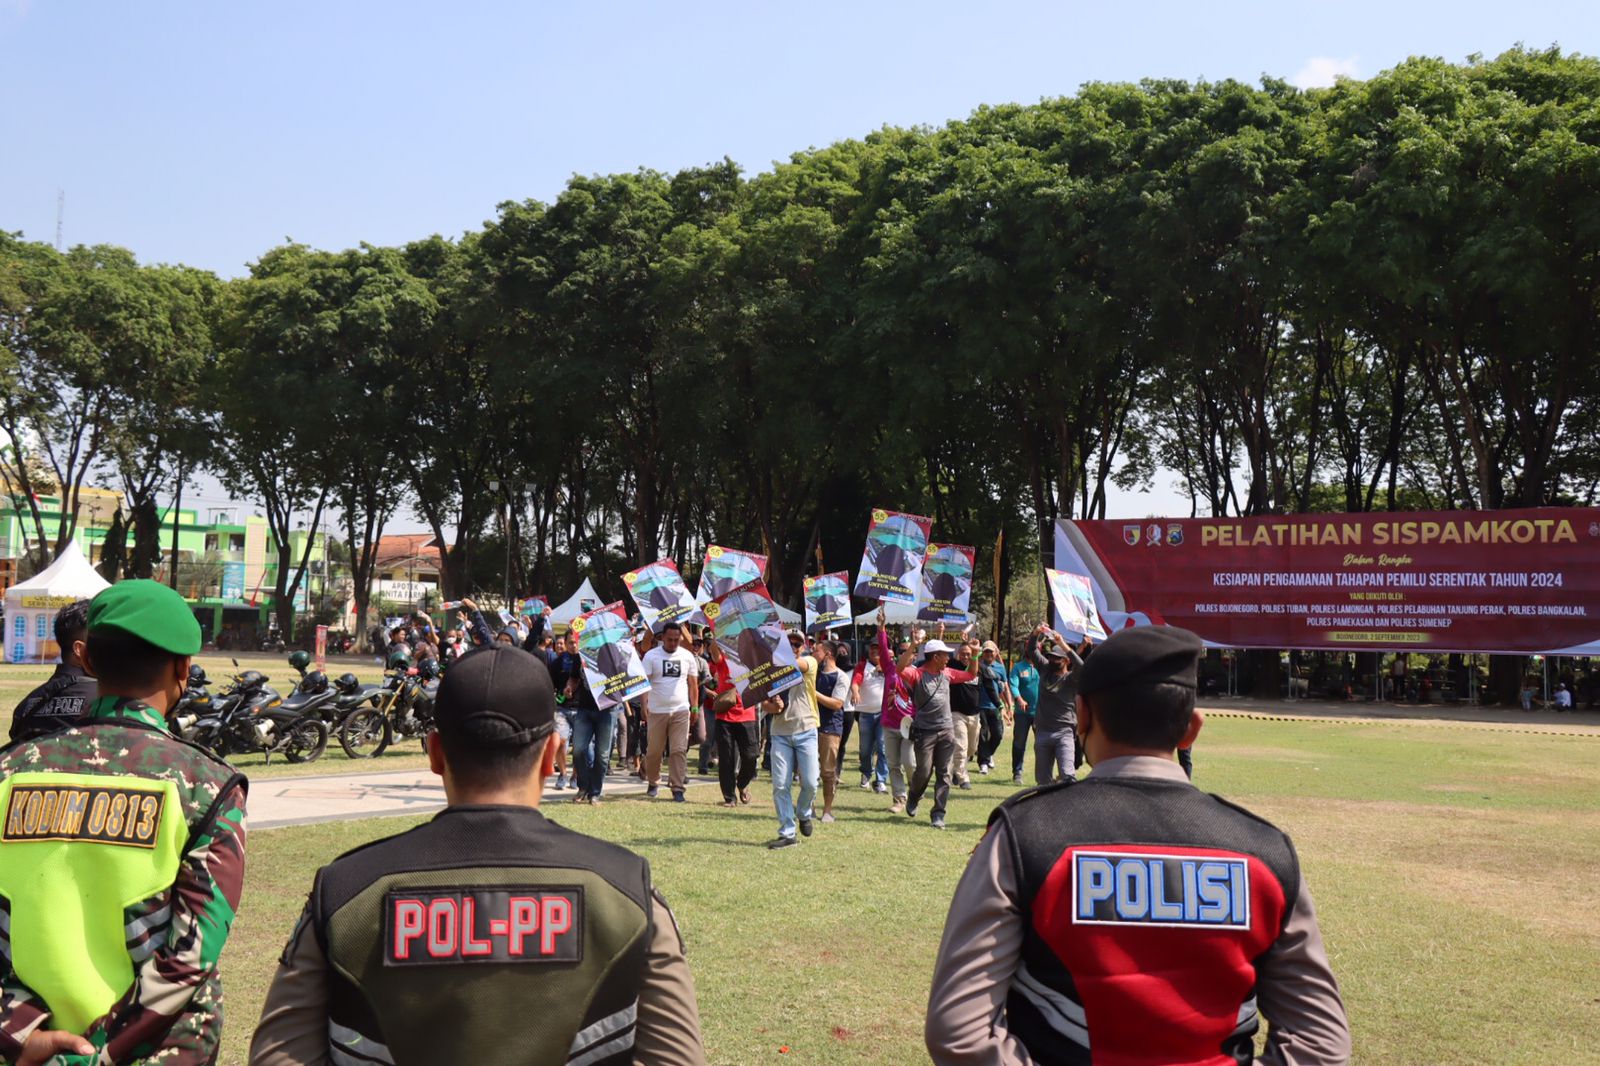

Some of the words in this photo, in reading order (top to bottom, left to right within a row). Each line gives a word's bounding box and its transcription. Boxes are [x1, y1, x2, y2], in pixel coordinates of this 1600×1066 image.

[874, 512, 885, 521] 55
[1201, 523, 1361, 547] PELATIHAN
[1372, 519, 1578, 544] SISPAMKOTA
[1343, 553, 1375, 567] Dalam
[1378, 553, 1412, 567] Rangka
[1213, 573, 1261, 586] KESIAPAN
[1263, 573, 1333, 586] PENGAMANAN
[1336, 573, 1384, 586] TAHAPAN
[1386, 573, 1426, 586] PEMILU
[1429, 573, 1487, 587] SERENTAK
[1489, 573, 1528, 587] TAHUN
[1530, 572, 1563, 587] 2024
[1349, 592, 1365, 600] YANG
[706, 604, 719, 617] 55
[1195, 604, 1218, 613] POLRES
[1219, 604, 1261, 614] BOJONEGORO,
[1261, 604, 1285, 613] POLRES
[1286, 604, 1310, 614] TUBAN,
[1310, 604, 1336, 614] POLRES
[1337, 604, 1376, 615] LAMONGAN,
[1377, 605, 1403, 614] POLRES
[1404, 605, 1446, 614] PELABUHAN
[1447, 605, 1479, 614] TANJUNG
[1480, 605, 1507, 615] PERAK,
[1507, 605, 1536, 615] POLRES
[1537, 606, 1587, 616] BANGKALAN,
[1306, 617, 1332, 626] POLRES
[1333, 617, 1374, 626] PAMEKASAN
[1375, 617, 1390, 627] DAN
[1390, 618, 1417, 627] POLRES
[1418, 618, 1452, 628] SUMENEP
[665, 661, 679, 674] Ps
[54, 698, 84, 714] POLRI
[7, 790, 90, 836] KODIM
[88, 792, 159, 840] 0813
[1077, 856, 1246, 923] POLISI
[394, 896, 573, 960] POL-PP
